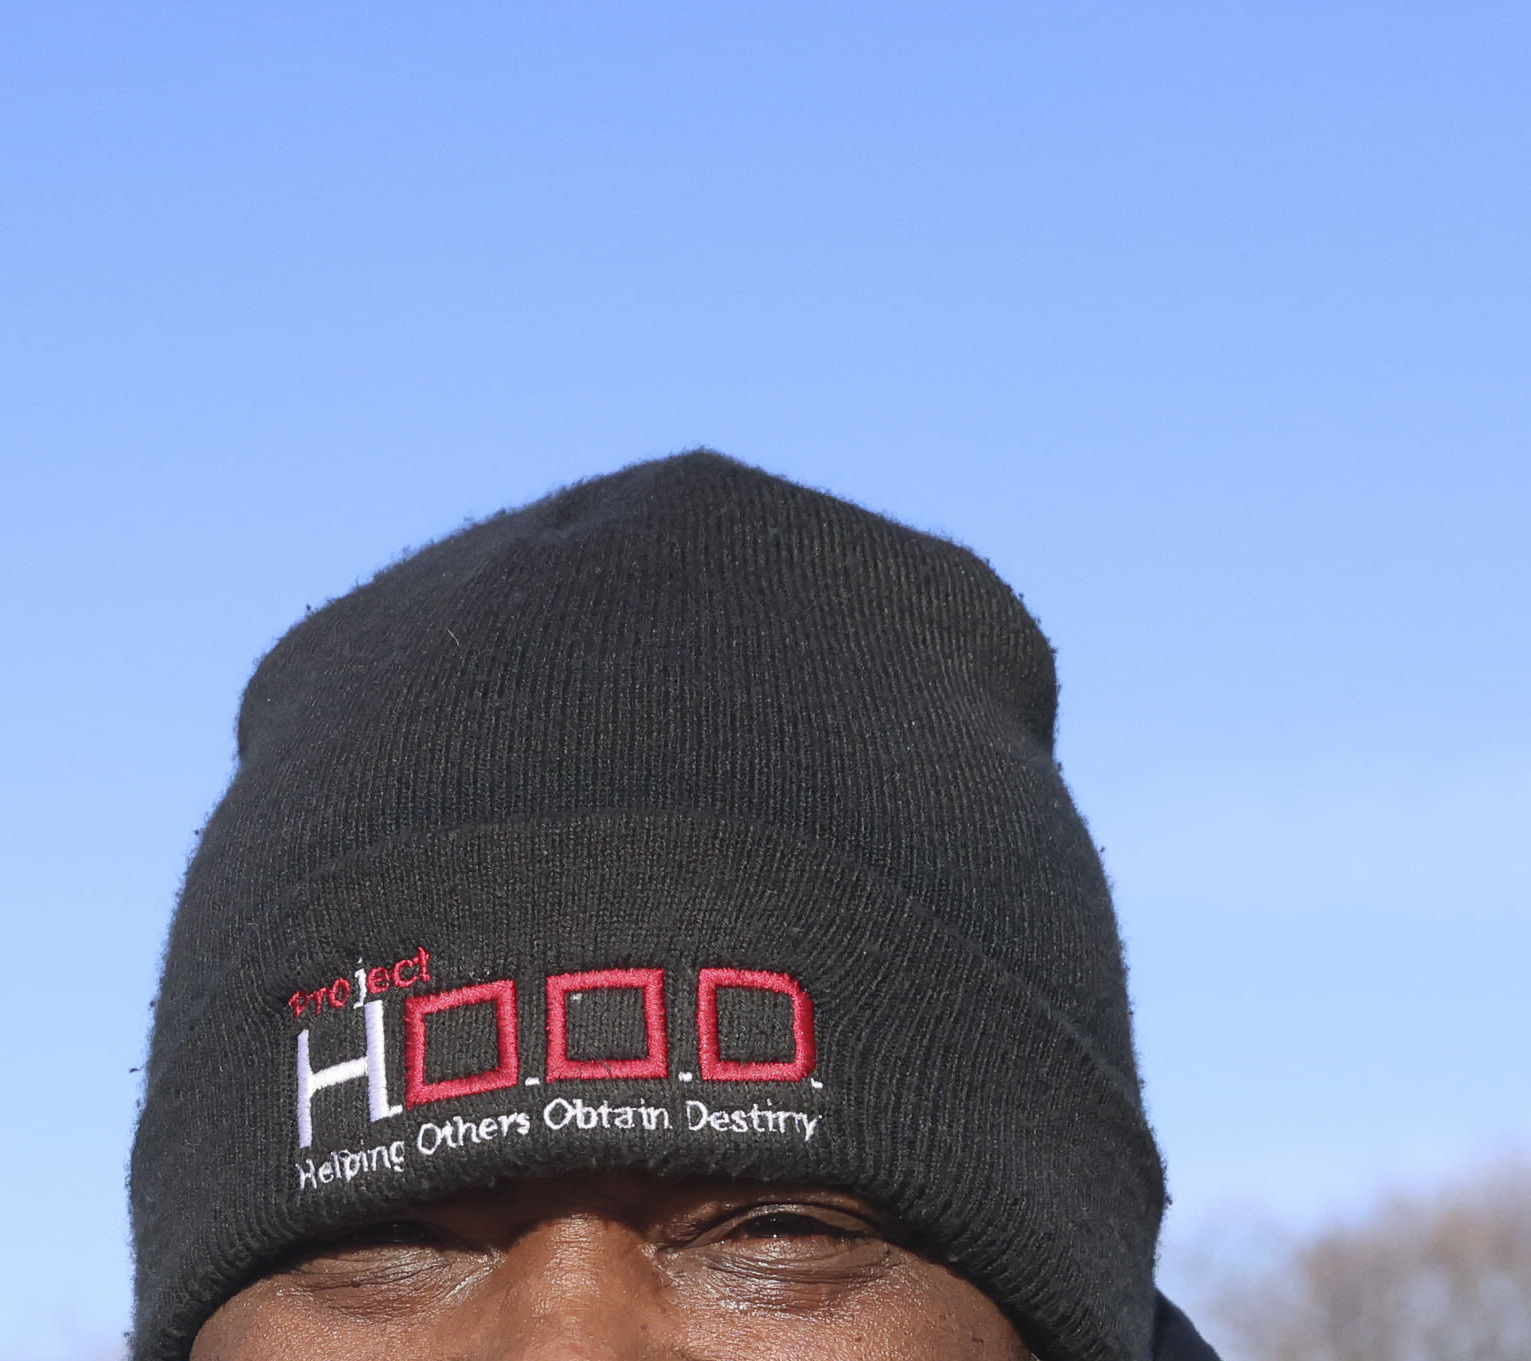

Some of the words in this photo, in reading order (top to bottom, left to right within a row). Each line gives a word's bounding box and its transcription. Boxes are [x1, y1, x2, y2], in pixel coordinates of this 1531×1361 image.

[296, 1140, 406, 1190] Helping
[417, 1109, 531, 1156] Others
[544, 1097, 670, 1131] Obtain
[686, 1100, 821, 1141] Destiny
